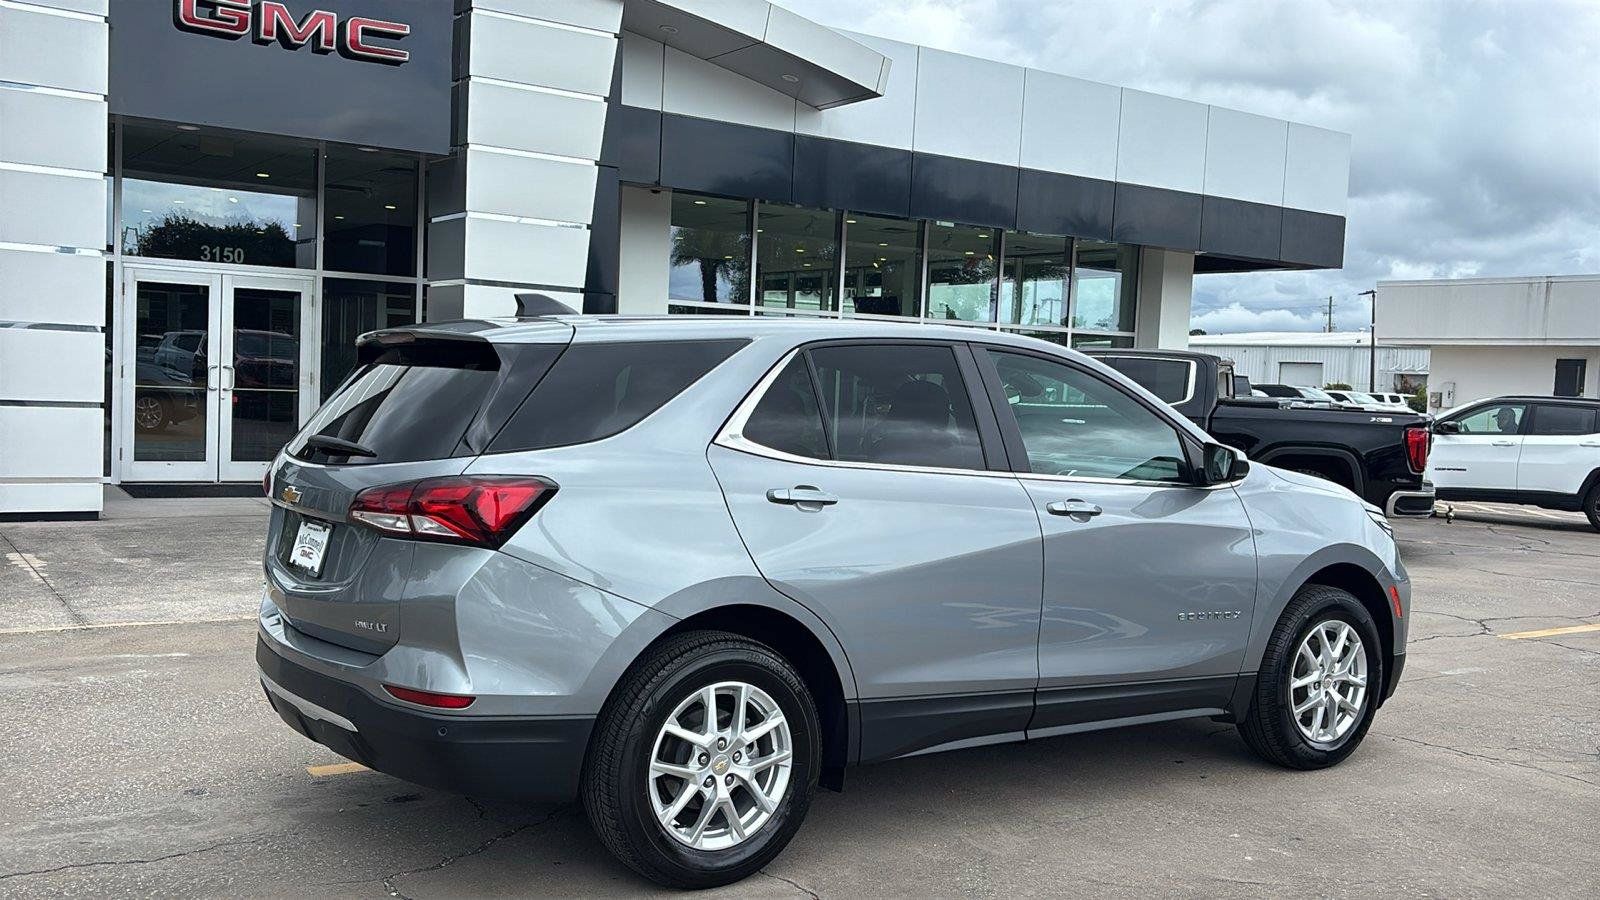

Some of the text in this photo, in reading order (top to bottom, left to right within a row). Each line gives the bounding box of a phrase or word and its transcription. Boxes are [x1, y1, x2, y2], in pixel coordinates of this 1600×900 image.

[175, 0, 411, 63] GMC
[200, 245, 245, 264] 3150
[1177, 610, 1241, 621] EQUINOX
[376, 622, 388, 633] LT
